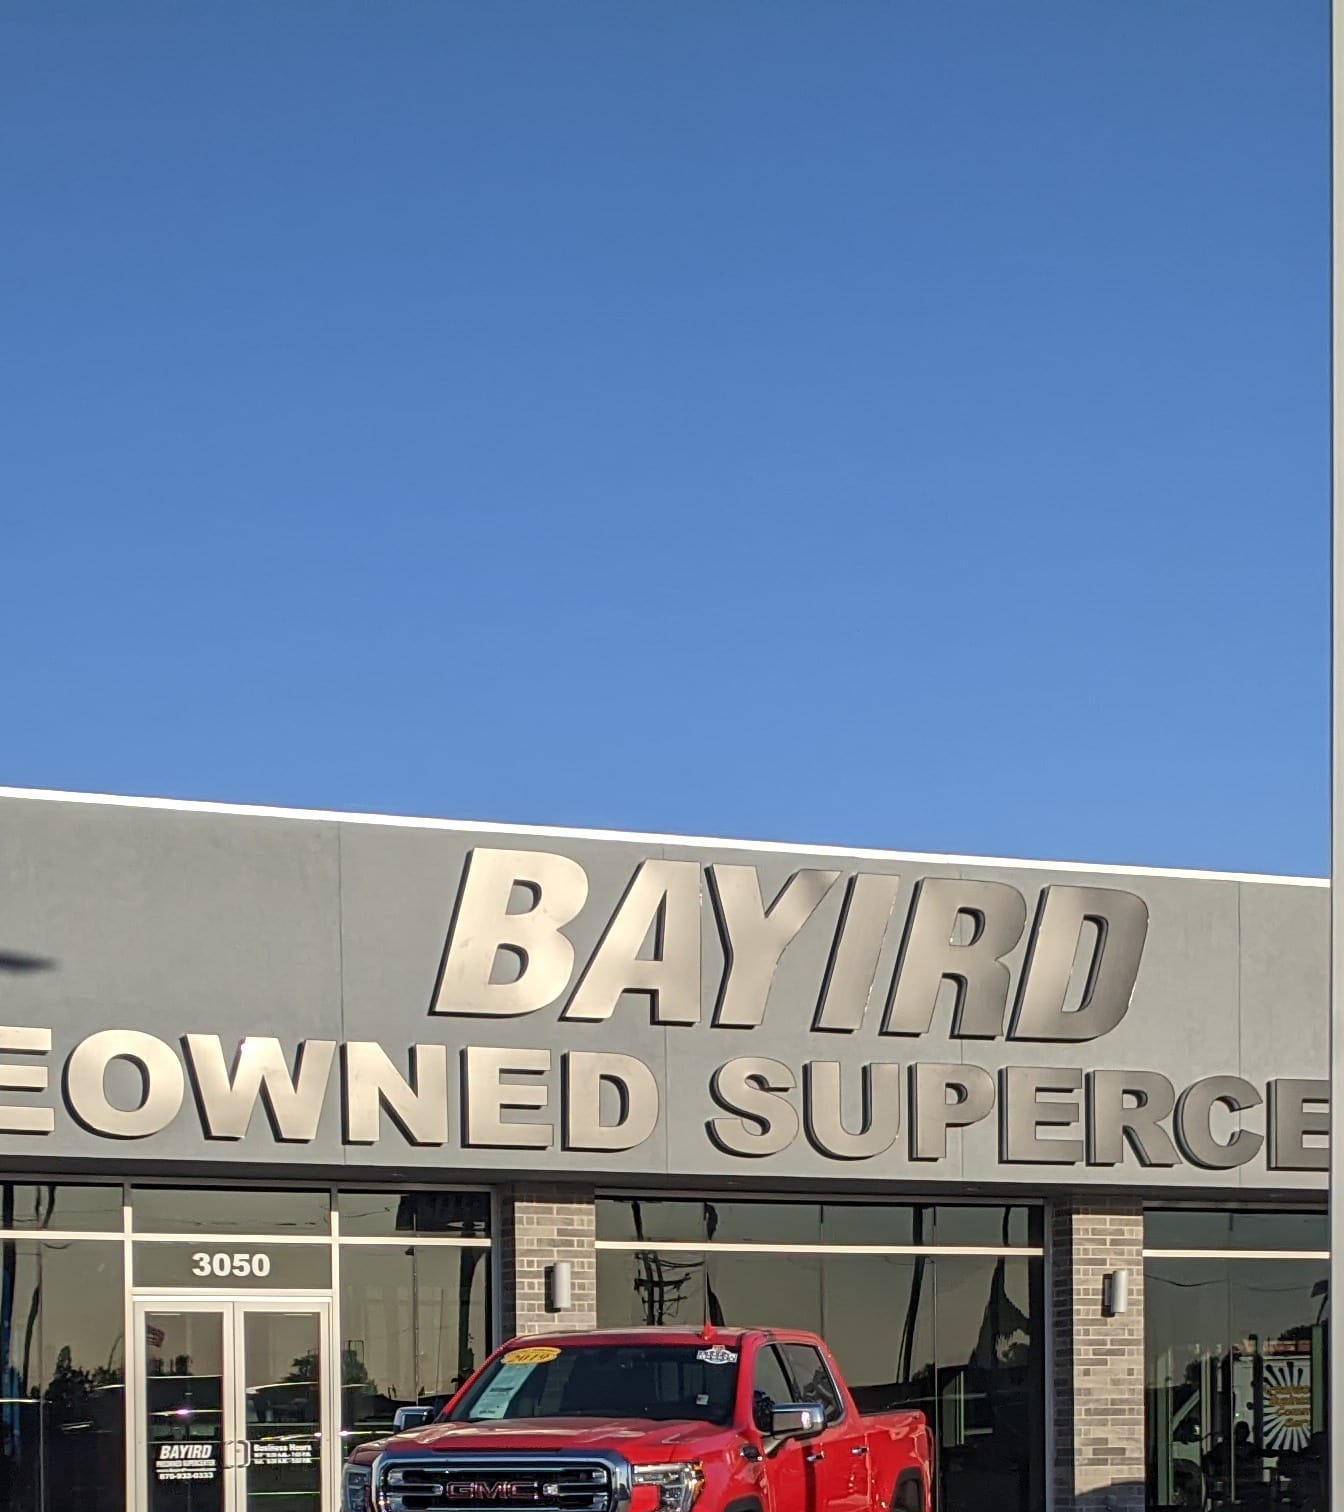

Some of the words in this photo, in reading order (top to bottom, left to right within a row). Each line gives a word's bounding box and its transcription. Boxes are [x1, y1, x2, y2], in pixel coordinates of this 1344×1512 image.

[430, 847, 1150, 1041] BAYIRD
[192, 1253, 270, 1277] 3050
[160, 1445, 212, 1459] BAYIRD
[446, 1481, 539, 1499] GMC
